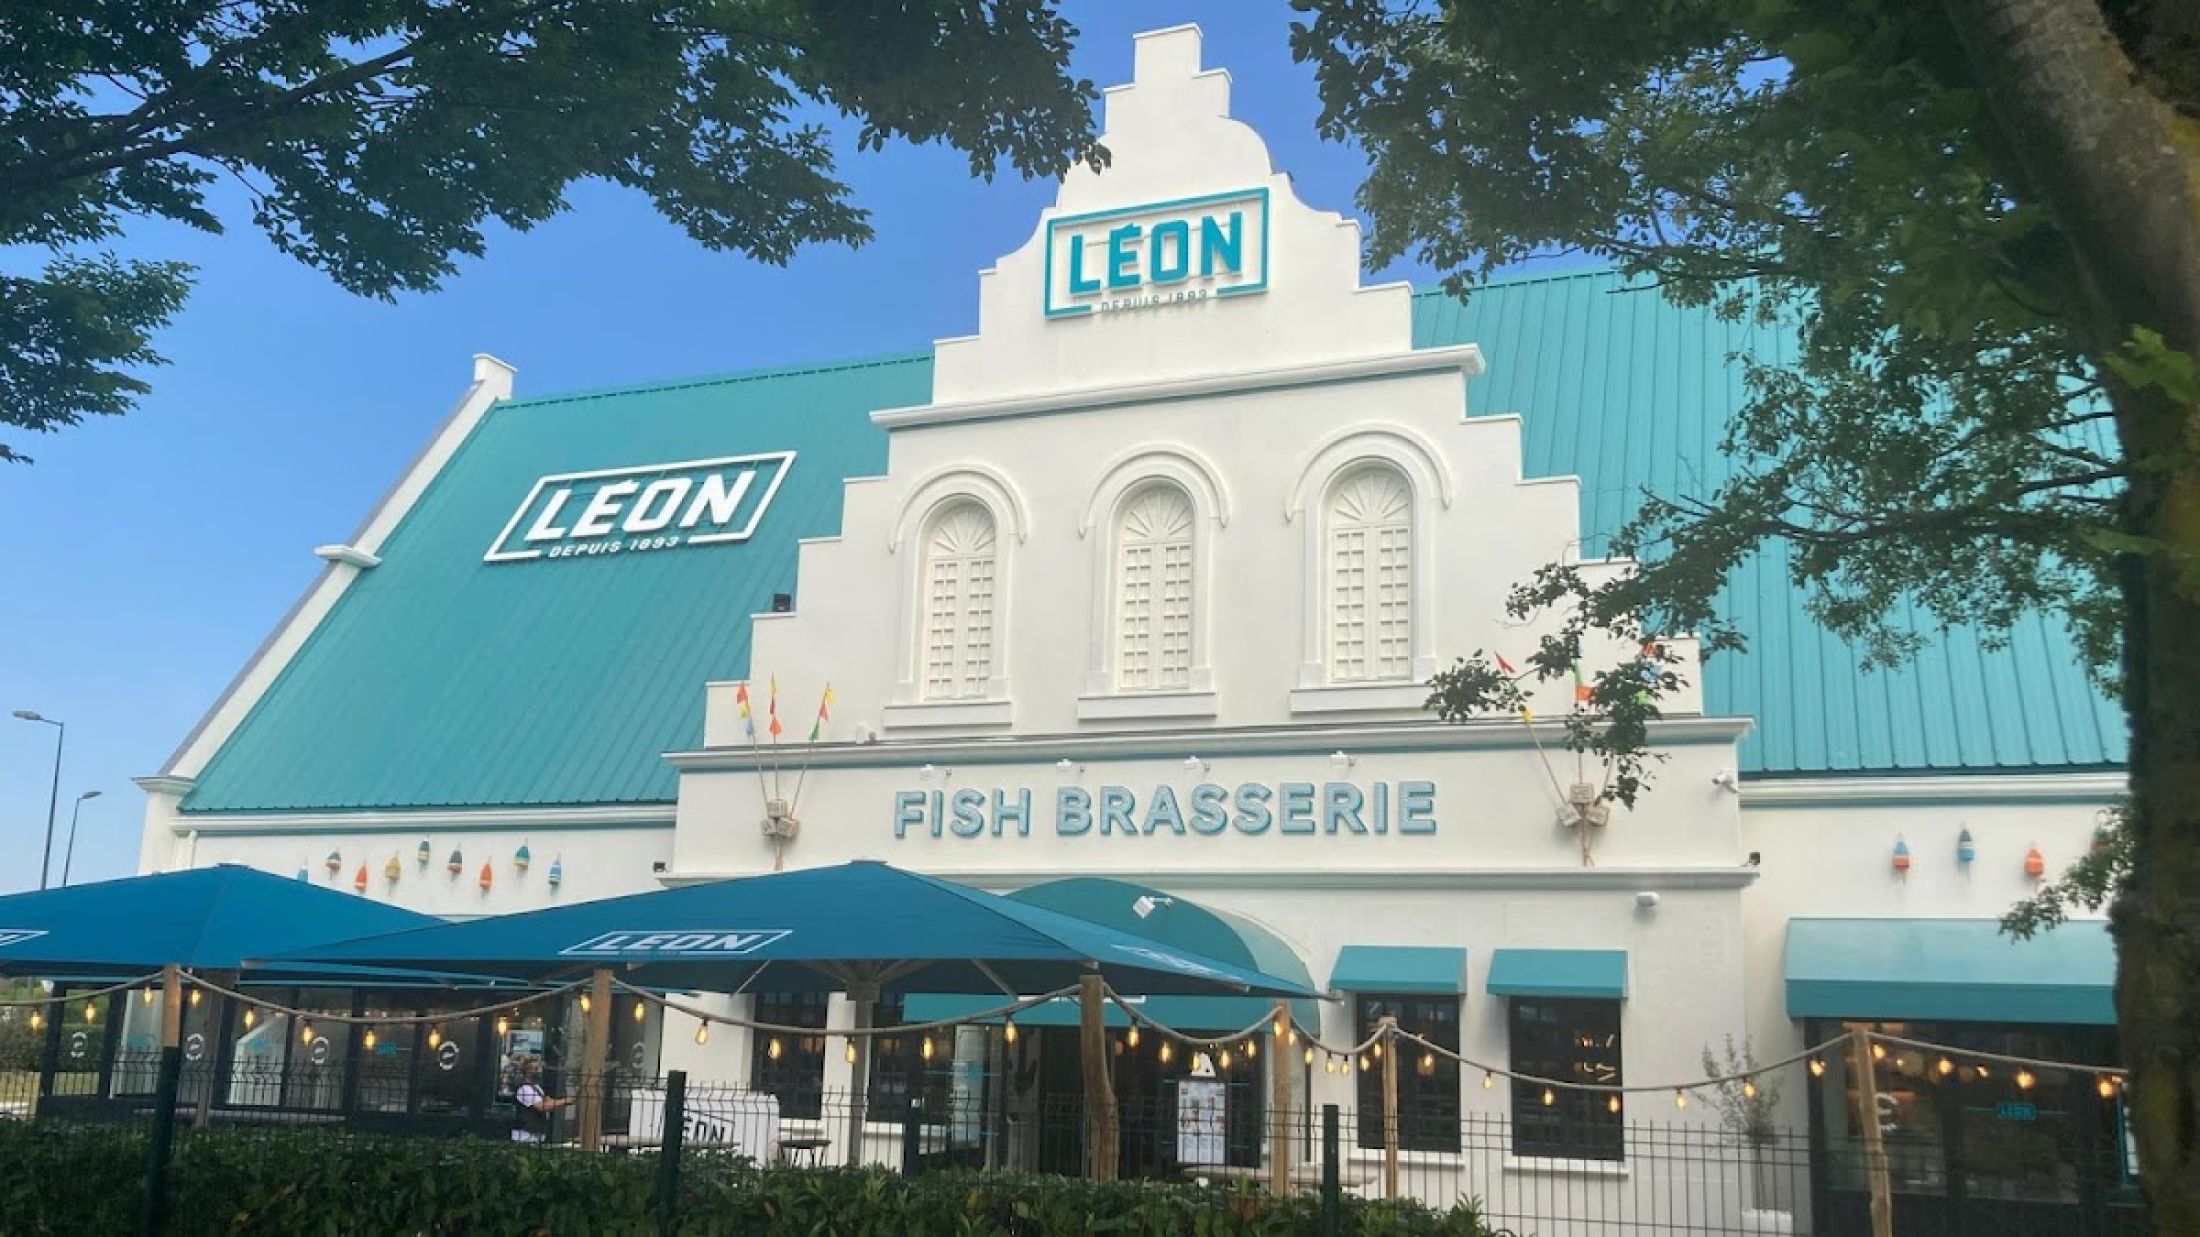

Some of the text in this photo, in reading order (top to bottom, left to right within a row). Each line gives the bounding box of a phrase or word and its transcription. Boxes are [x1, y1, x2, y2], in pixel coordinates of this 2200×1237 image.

[1069, 211, 1243, 296] LÉON
[1101, 294, 1160, 312] DEPUIS
[524, 470, 757, 541] LÉON
[548, 536, 680, 558] DEPUIS 1893
[894, 780, 1437, 838] FISH BRASSERIE
